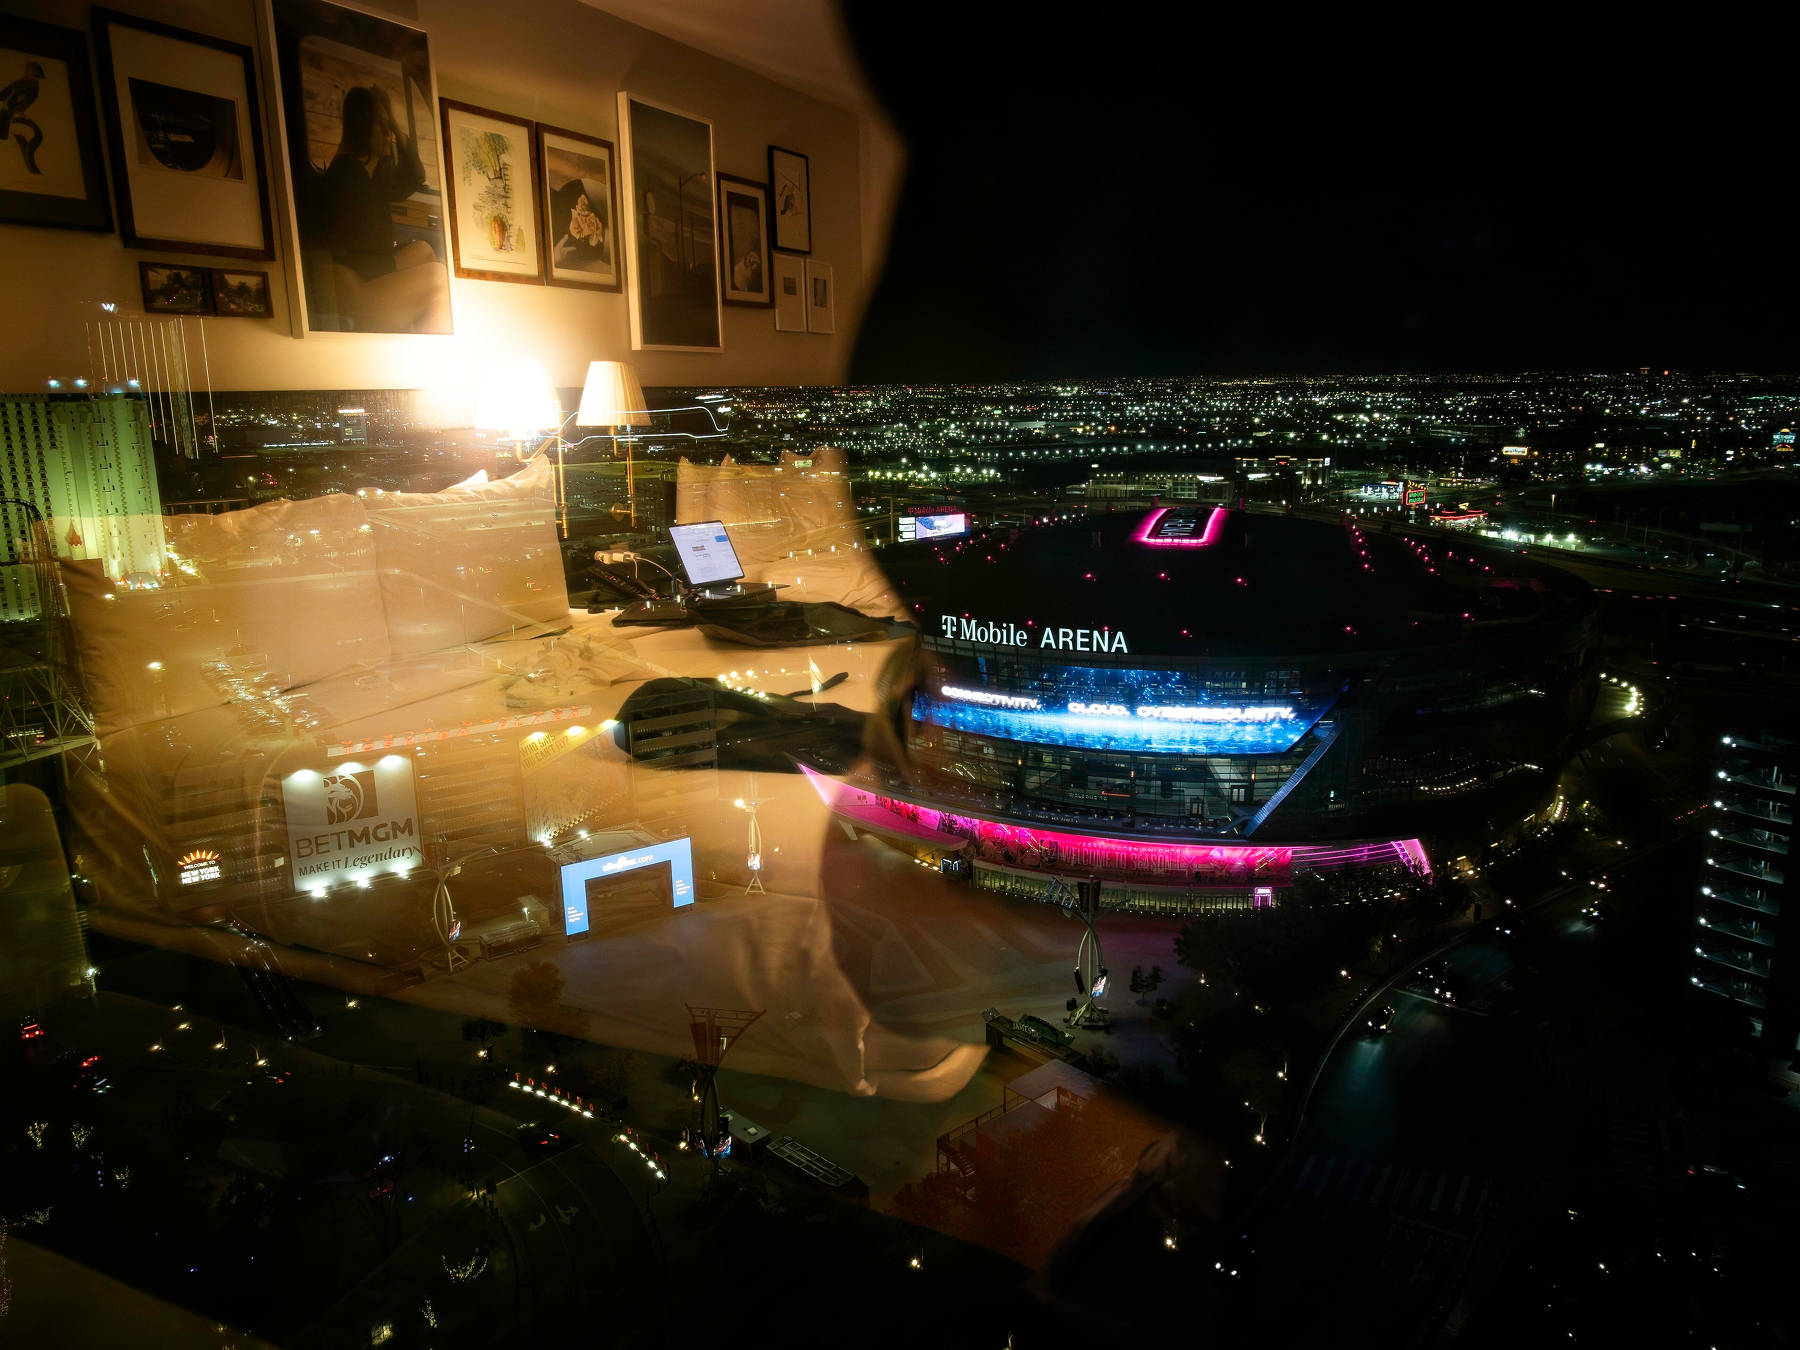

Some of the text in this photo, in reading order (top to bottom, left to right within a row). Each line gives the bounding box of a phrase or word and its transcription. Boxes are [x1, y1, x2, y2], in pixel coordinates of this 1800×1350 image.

[959, 617, 1028, 647] Mobile
[1040, 627, 1129, 654] ARENA
[342, 709, 579, 755] TOSHIBA PLAZA
[520, 732, 557, 758] WHO SAYS
[521, 755, 537, 770] YOU
[554, 735, 569, 751] FLY?
[296, 818, 414, 859] BETMGM
[181, 866, 220, 879] NEW YORK
[183, 861, 208, 870] WELCOME
[298, 846, 415, 876] MAKE IT Legendary
[1061, 846, 1112, 868] WELCOME
[1115, 851, 1127, 870] TO
[1131, 852, 1172, 872] SEASON
[182, 872, 221, 885] NEW YORK
[514, 1072, 595, 1111] TOSHIBA
